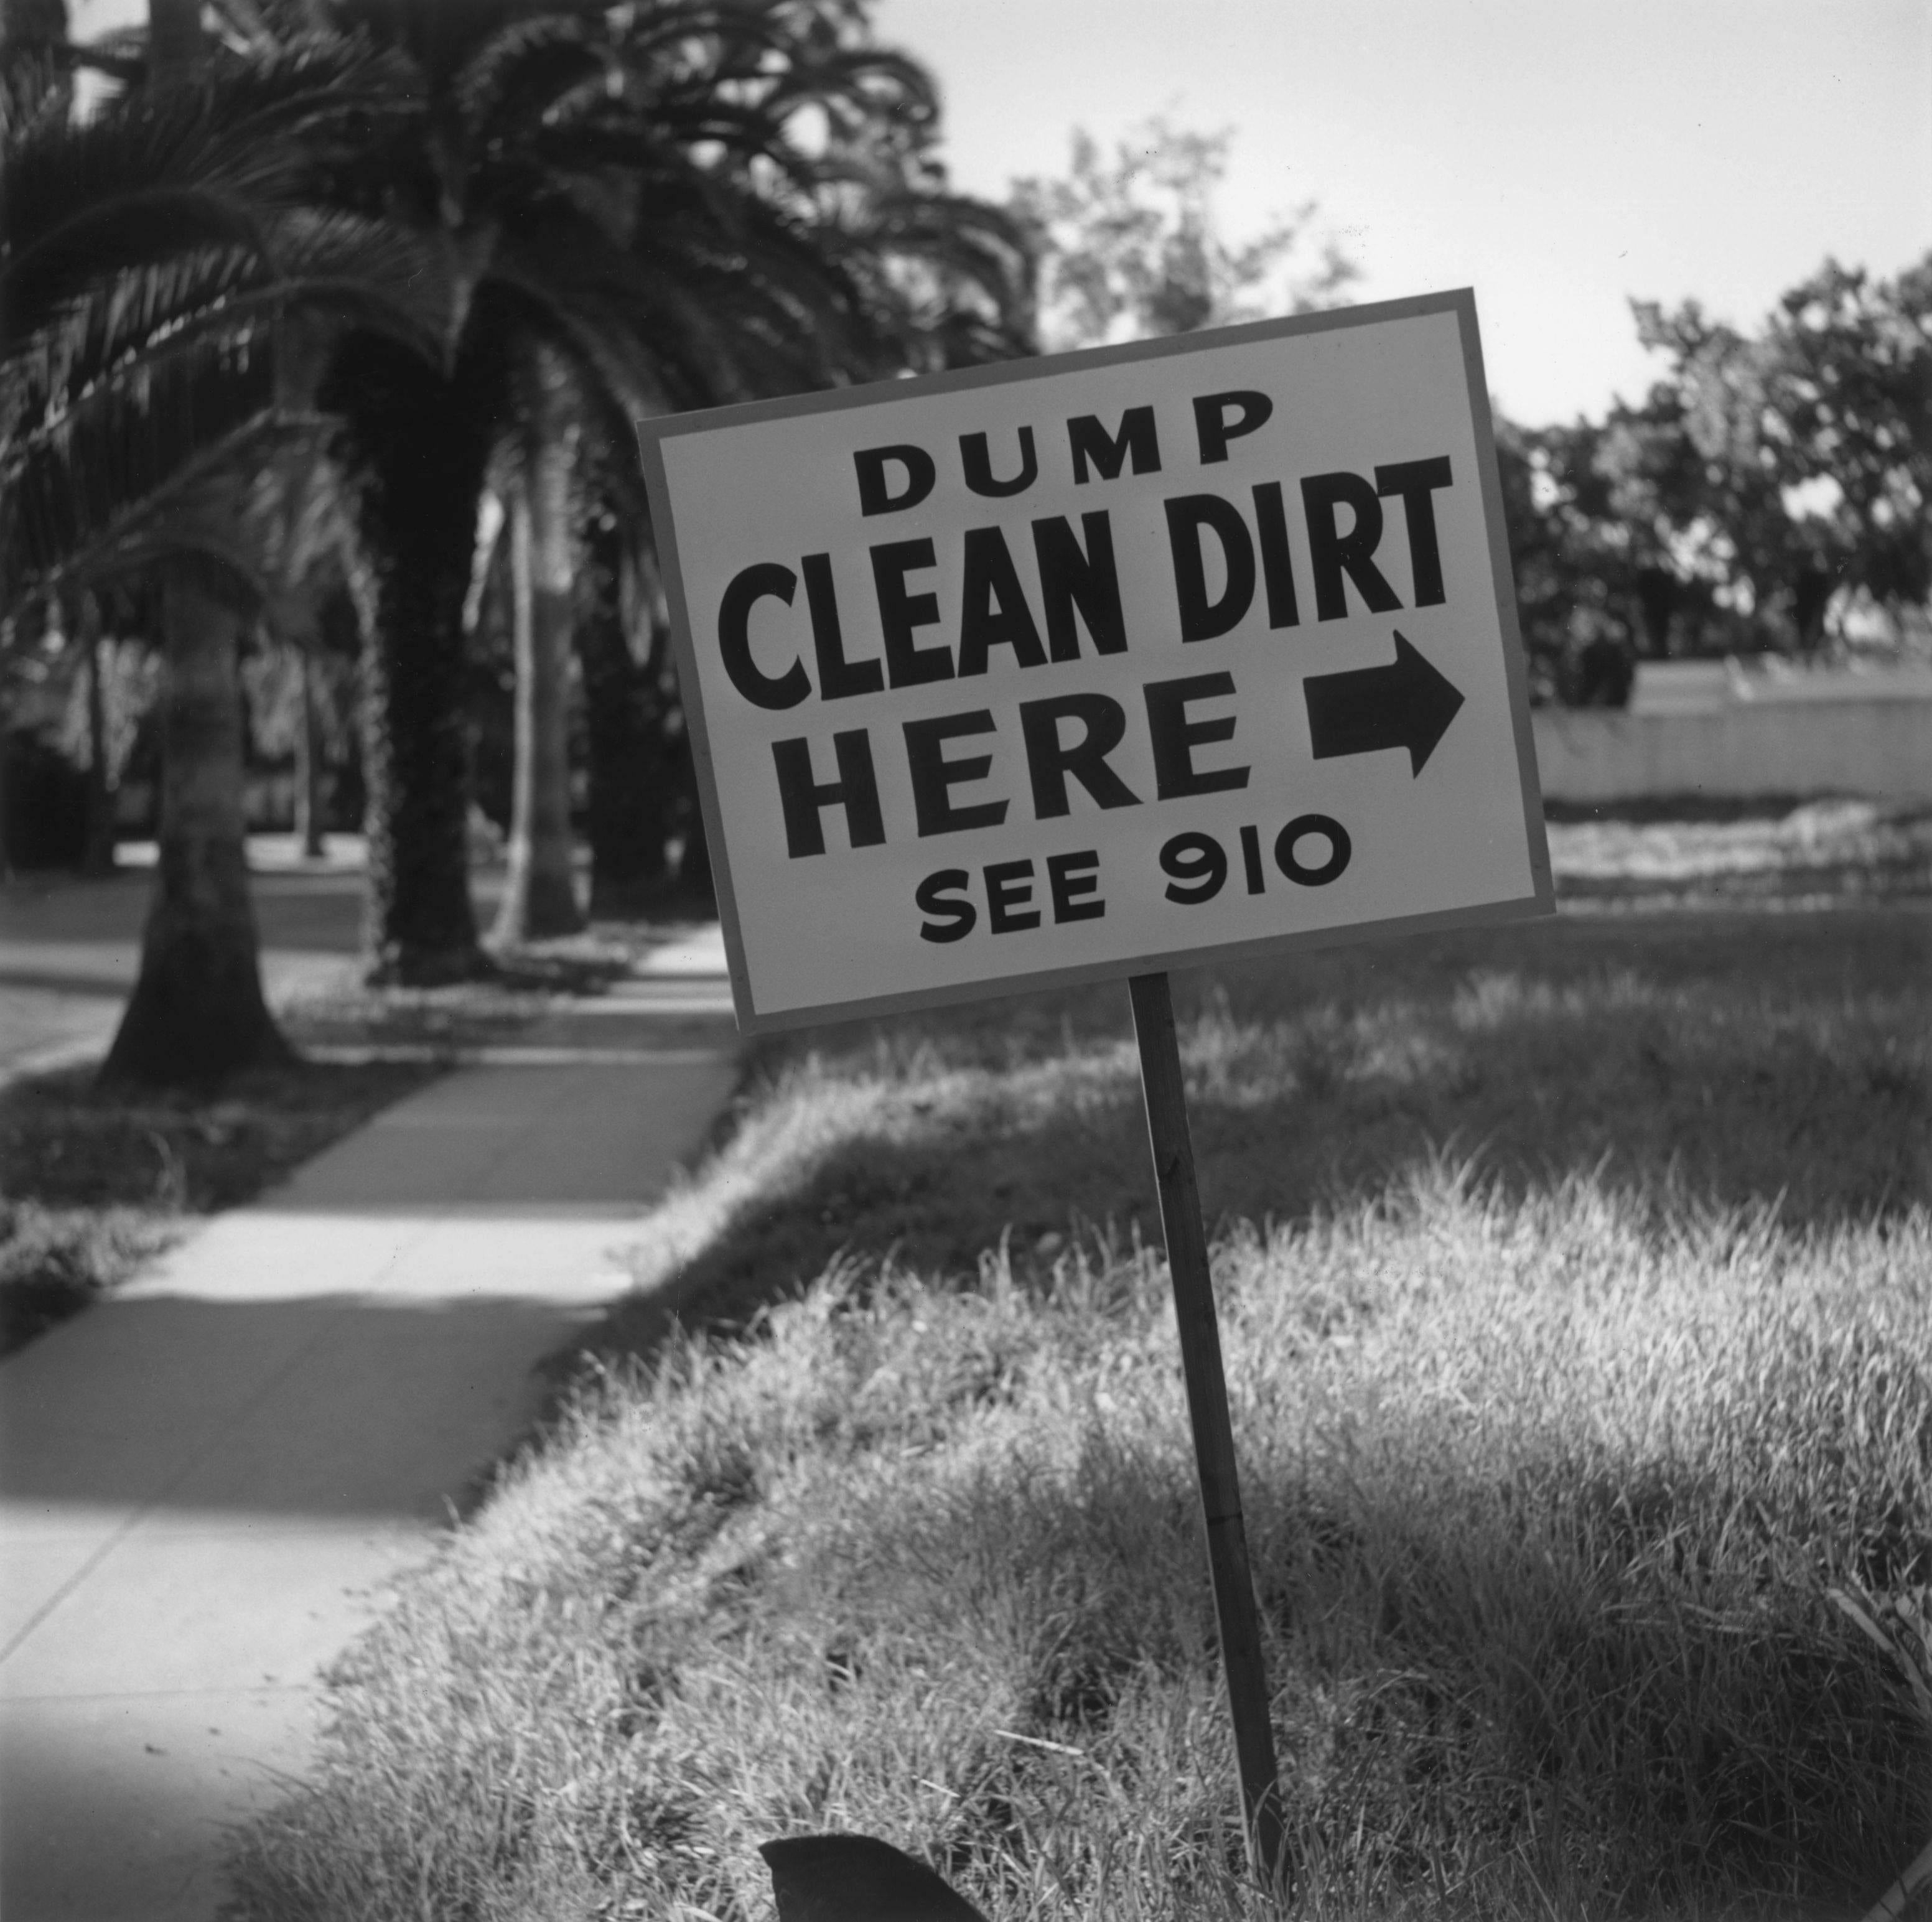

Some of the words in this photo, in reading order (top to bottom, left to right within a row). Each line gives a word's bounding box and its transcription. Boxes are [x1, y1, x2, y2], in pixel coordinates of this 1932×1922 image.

[853, 390, 1274, 517] DUMP
[717, 509, 1129, 711] CLEAN
[1163, 455, 1454, 644] DIRT
[771, 670, 1251, 859] HERE
[915, 849, 1106, 944] SEE
[1159, 813, 1352, 906] 910
